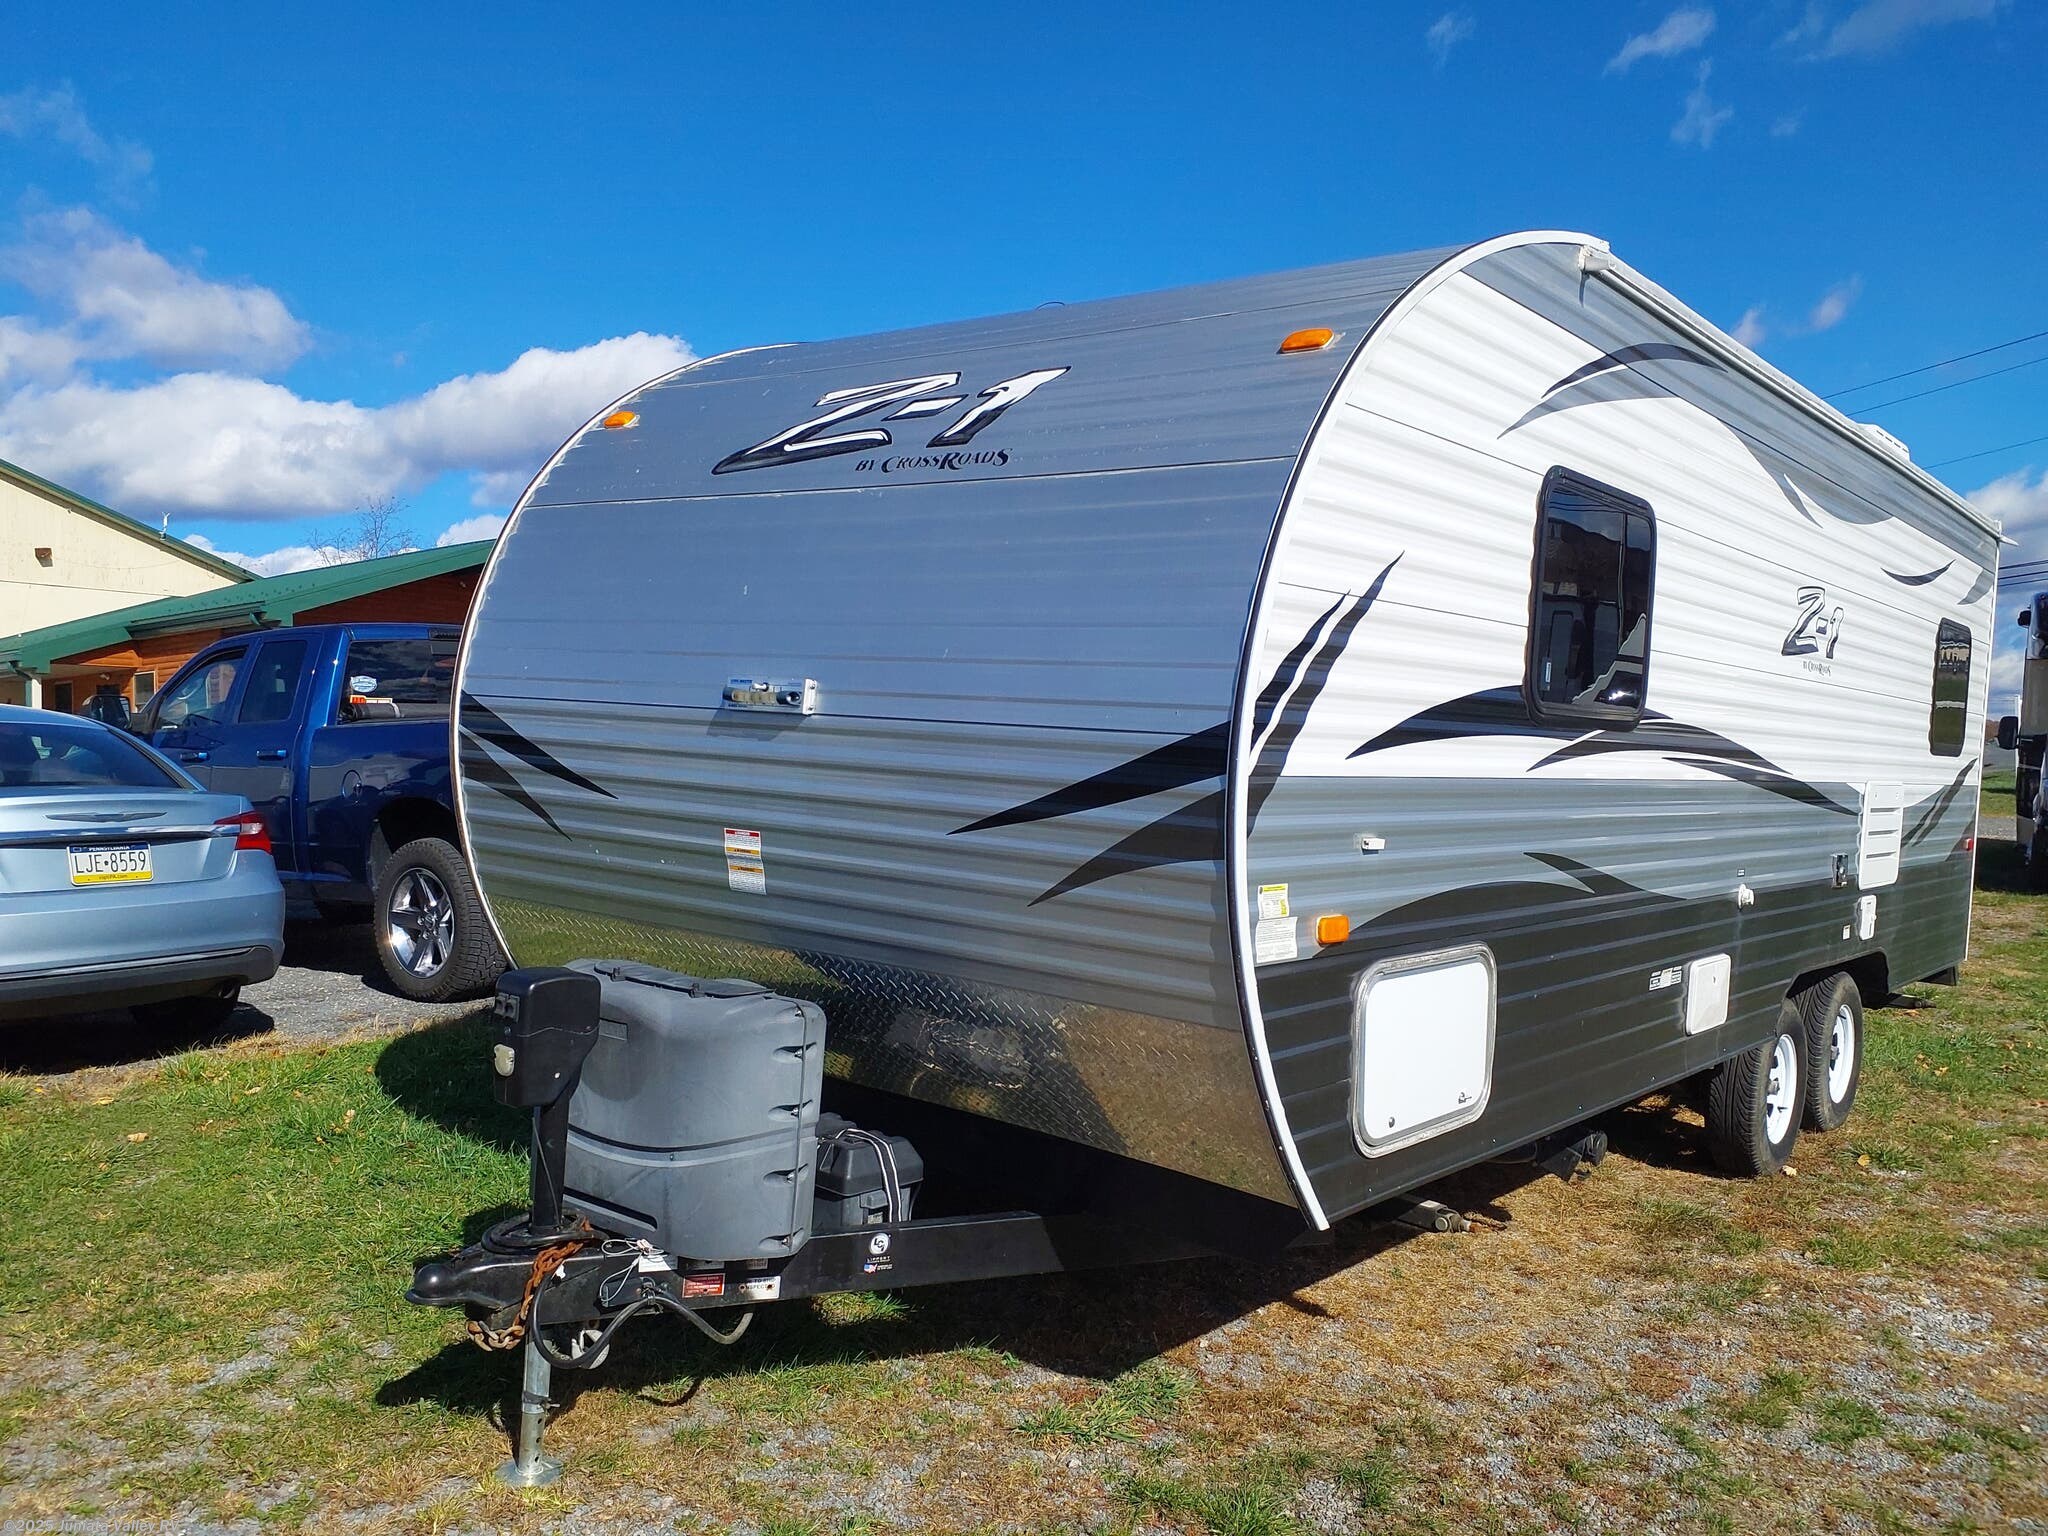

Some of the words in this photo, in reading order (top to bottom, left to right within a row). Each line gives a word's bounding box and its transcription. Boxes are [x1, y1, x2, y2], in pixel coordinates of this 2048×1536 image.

[711, 366, 1072, 476] Z-1
[855, 459, 880, 472] BY
[1781, 586, 1845, 660] Z-1
